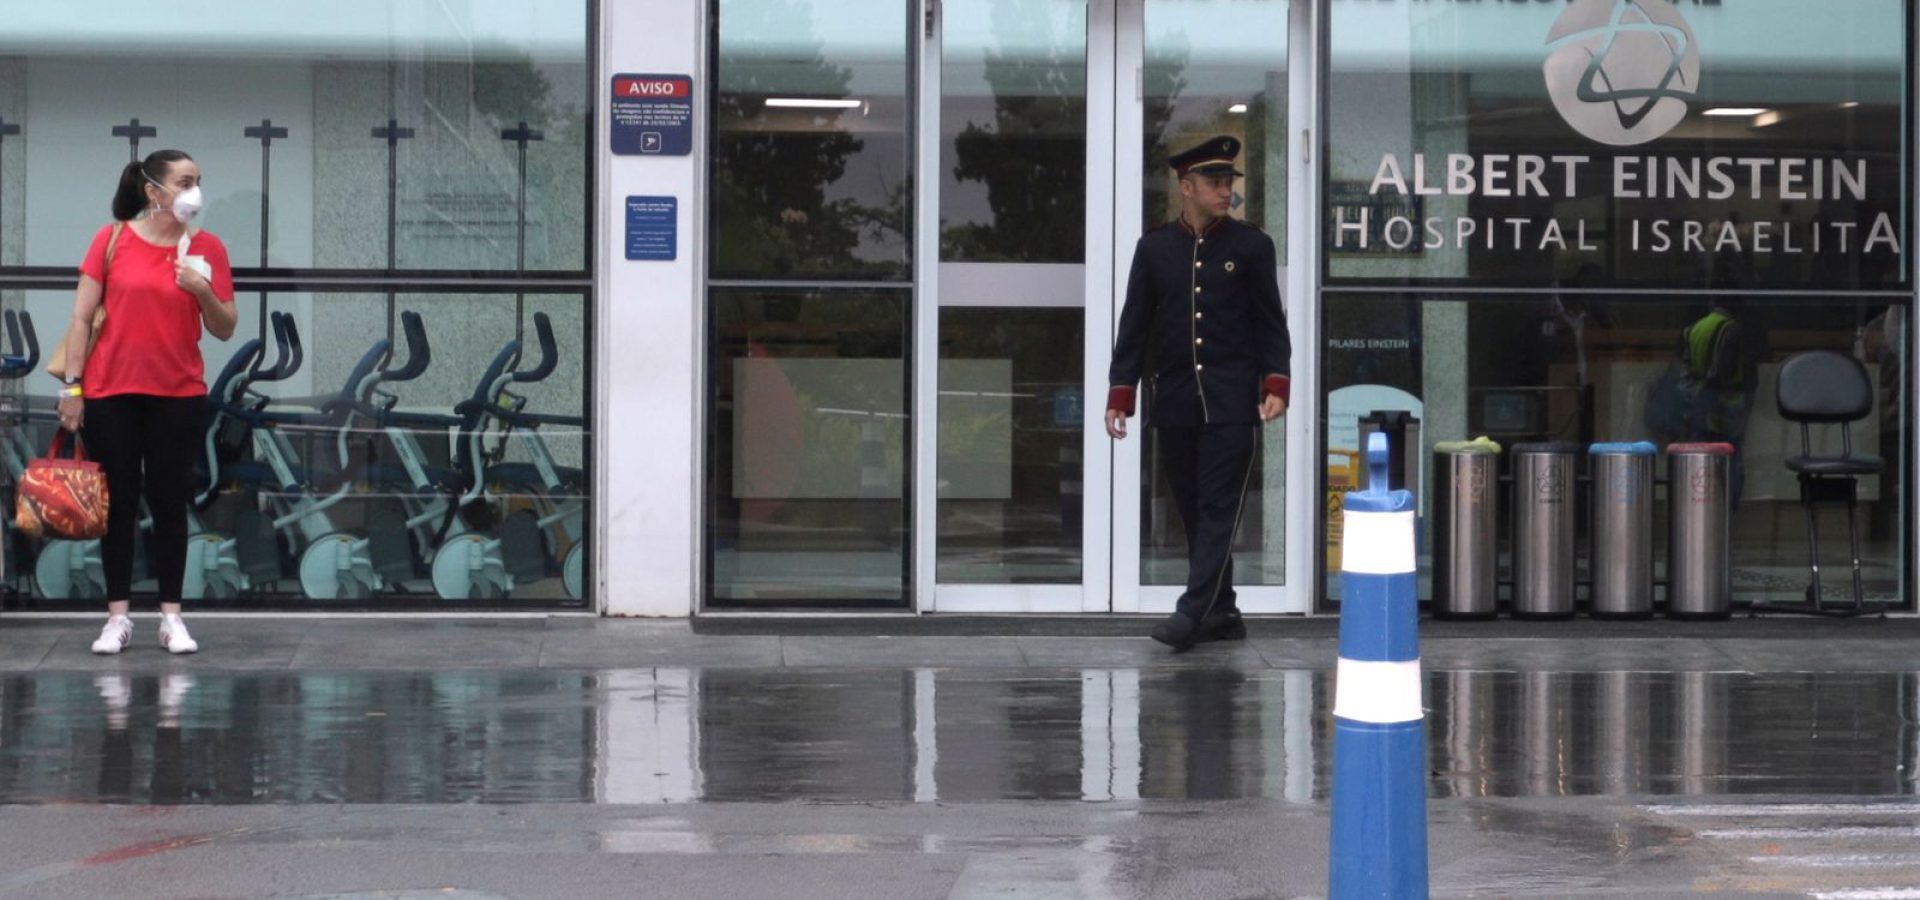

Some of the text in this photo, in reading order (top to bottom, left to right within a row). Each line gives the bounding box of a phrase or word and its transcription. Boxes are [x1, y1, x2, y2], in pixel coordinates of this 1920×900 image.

[629, 81, 674, 95] AVISO
[1368, 153, 1590, 198] ALBERT
[1613, 155, 1867, 200] EINSTEIN
[1334, 206, 1901, 254] HOSPITAL ISRAELITA
[1328, 338, 1410, 349] PILARES EINSTEIN
